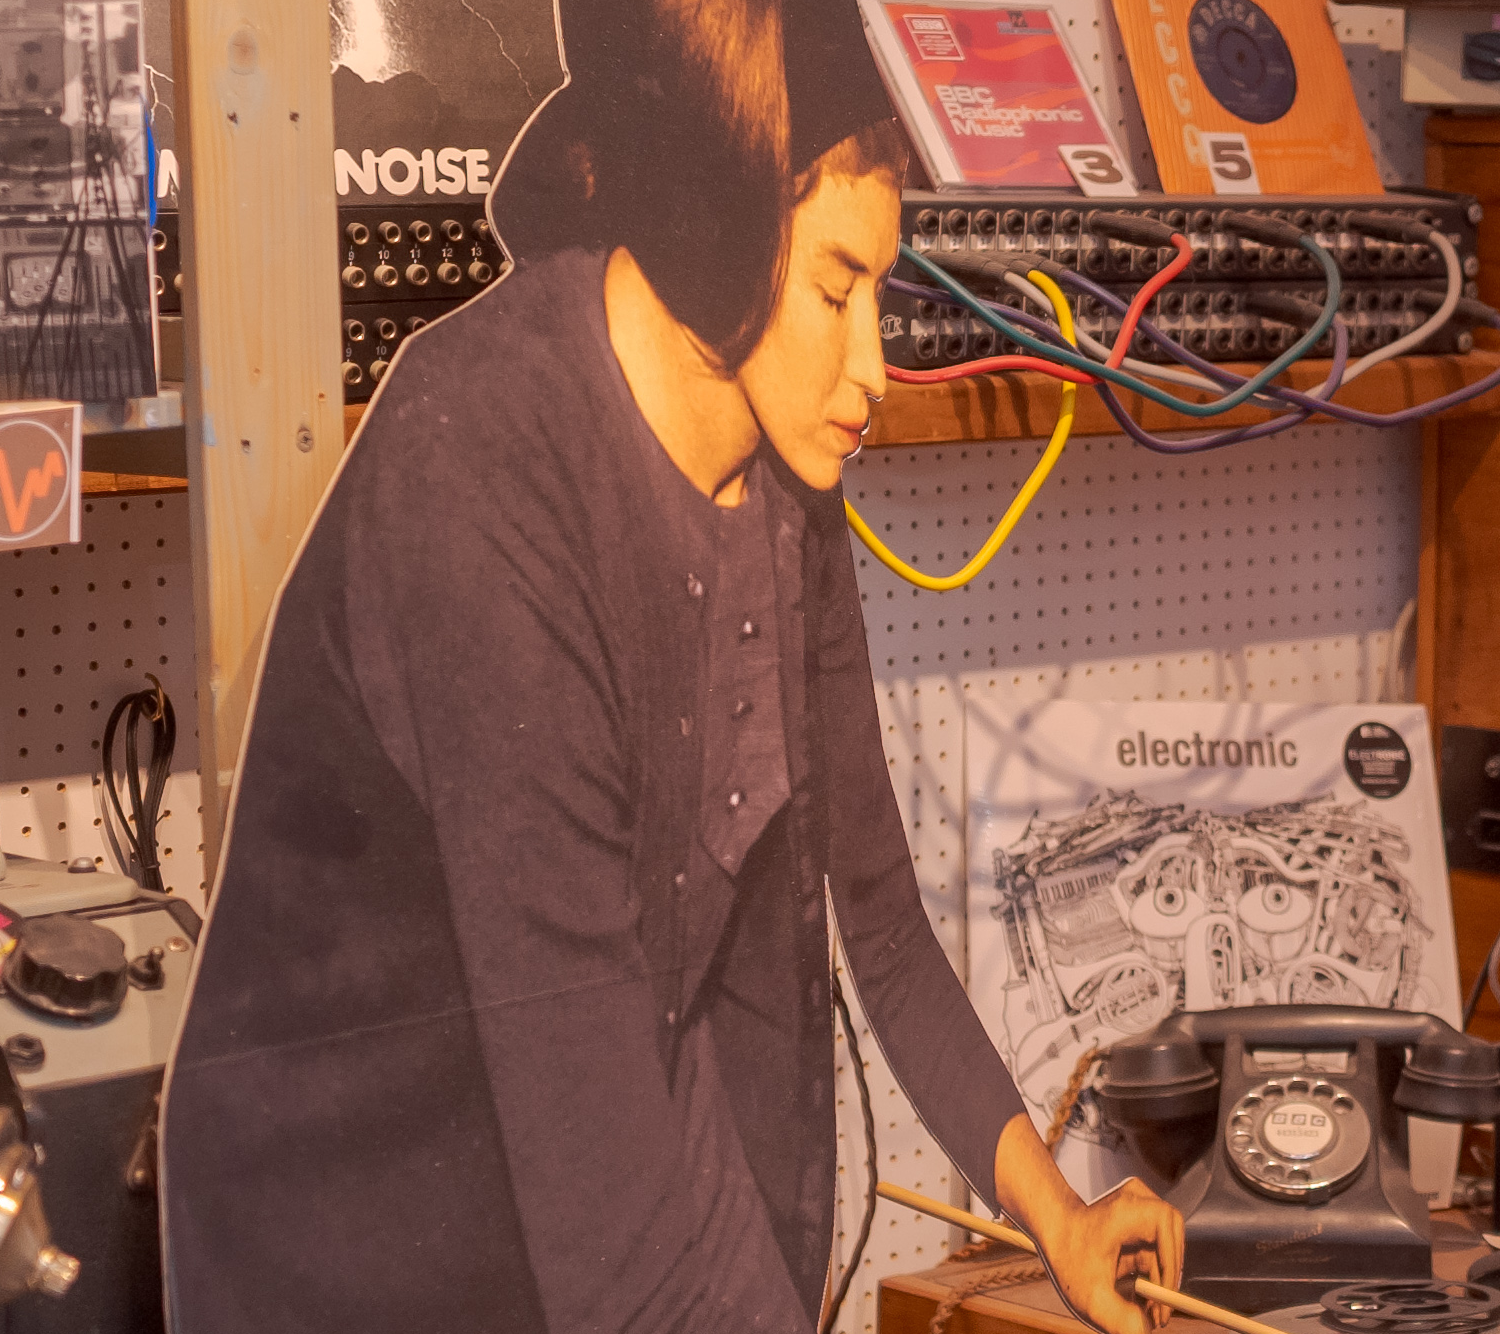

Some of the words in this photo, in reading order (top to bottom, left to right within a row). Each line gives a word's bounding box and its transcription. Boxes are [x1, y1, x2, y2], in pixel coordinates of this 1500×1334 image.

[934, 84, 995, 106] BBC
[946, 101, 1085, 126] Radiophonic
[952, 119, 1026, 139] Music
[1069, 149, 1125, 185] 3
[1208, 140, 1254, 182] 5
[334, 147, 492, 196] NOISE
[348, 251, 355, 261] 9
[378, 249, 390, 260] 10
[409, 248, 421, 259] 11
[442, 247, 453, 258] 12
[470, 247, 482, 257] 13
[345, 347, 352, 357] 9
[376, 346, 387, 356] 10
[1116, 729, 1299, 769] electronic
